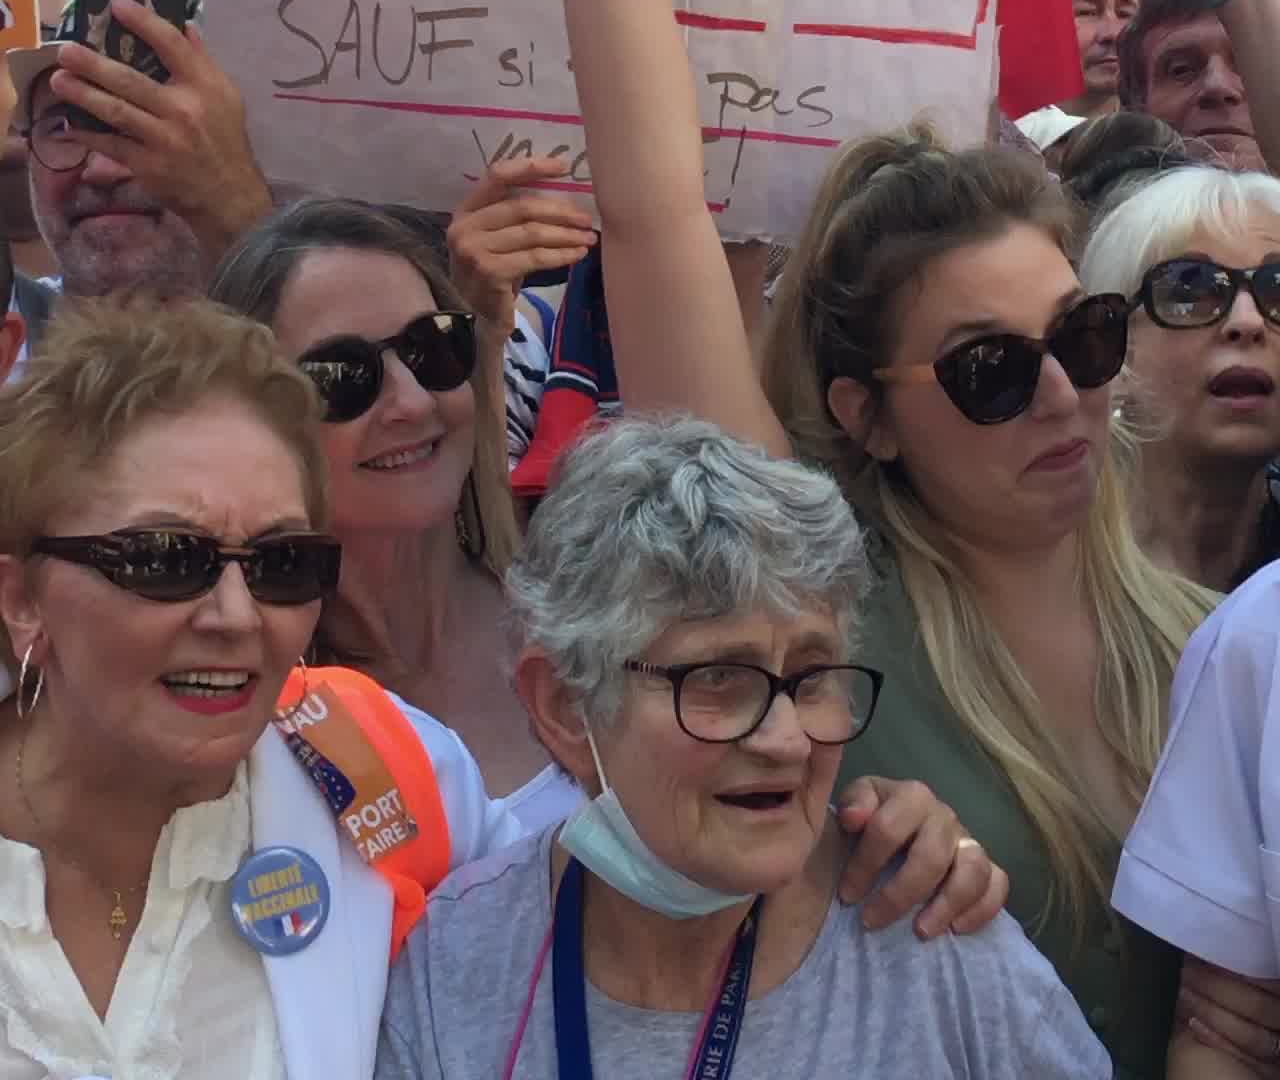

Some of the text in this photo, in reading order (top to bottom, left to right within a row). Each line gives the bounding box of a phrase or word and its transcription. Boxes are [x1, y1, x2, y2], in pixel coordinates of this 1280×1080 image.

[497, 40, 535, 87] si
[345, 788, 403, 839] PORT
[701, 1046, 723, 1080] RIE
[712, 1014, 732, 1041] DE
